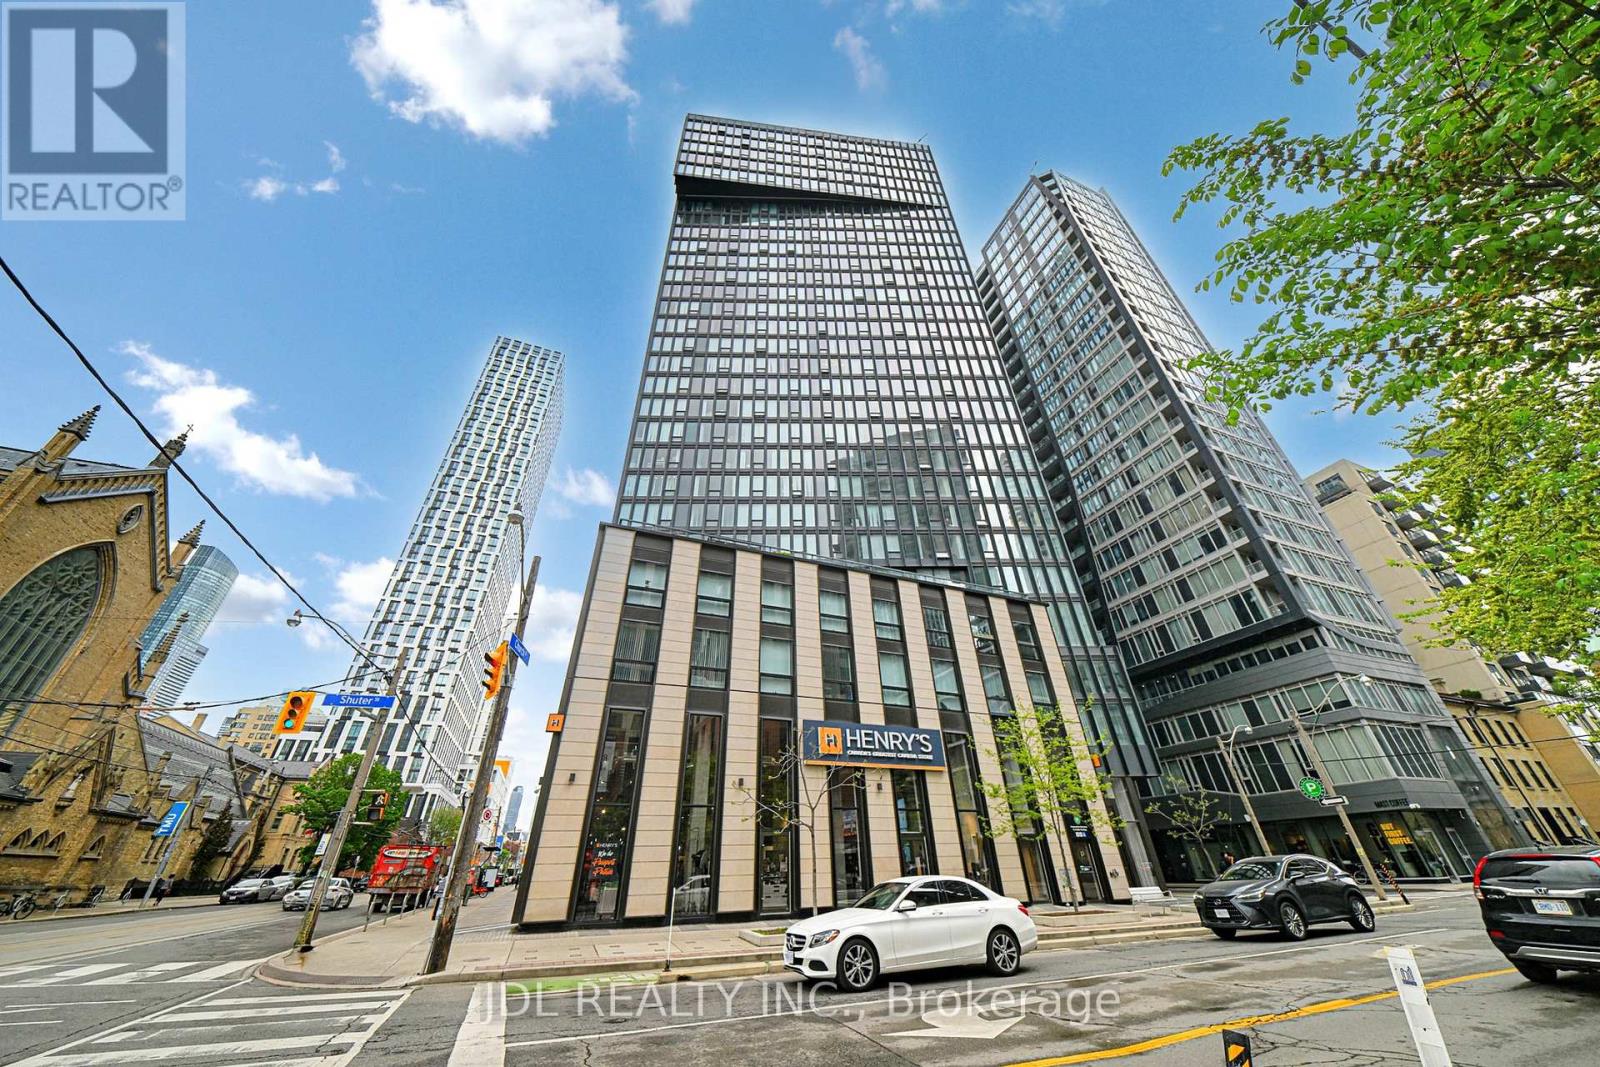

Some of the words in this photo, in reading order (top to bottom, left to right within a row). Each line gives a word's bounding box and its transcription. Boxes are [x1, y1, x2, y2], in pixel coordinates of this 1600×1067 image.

[340, 695, 373, 705] Shuter
[846, 729, 932, 753] HENRY'S
[1305, 783, 1316, 792] P
[157, 813, 177, 834] TMU
